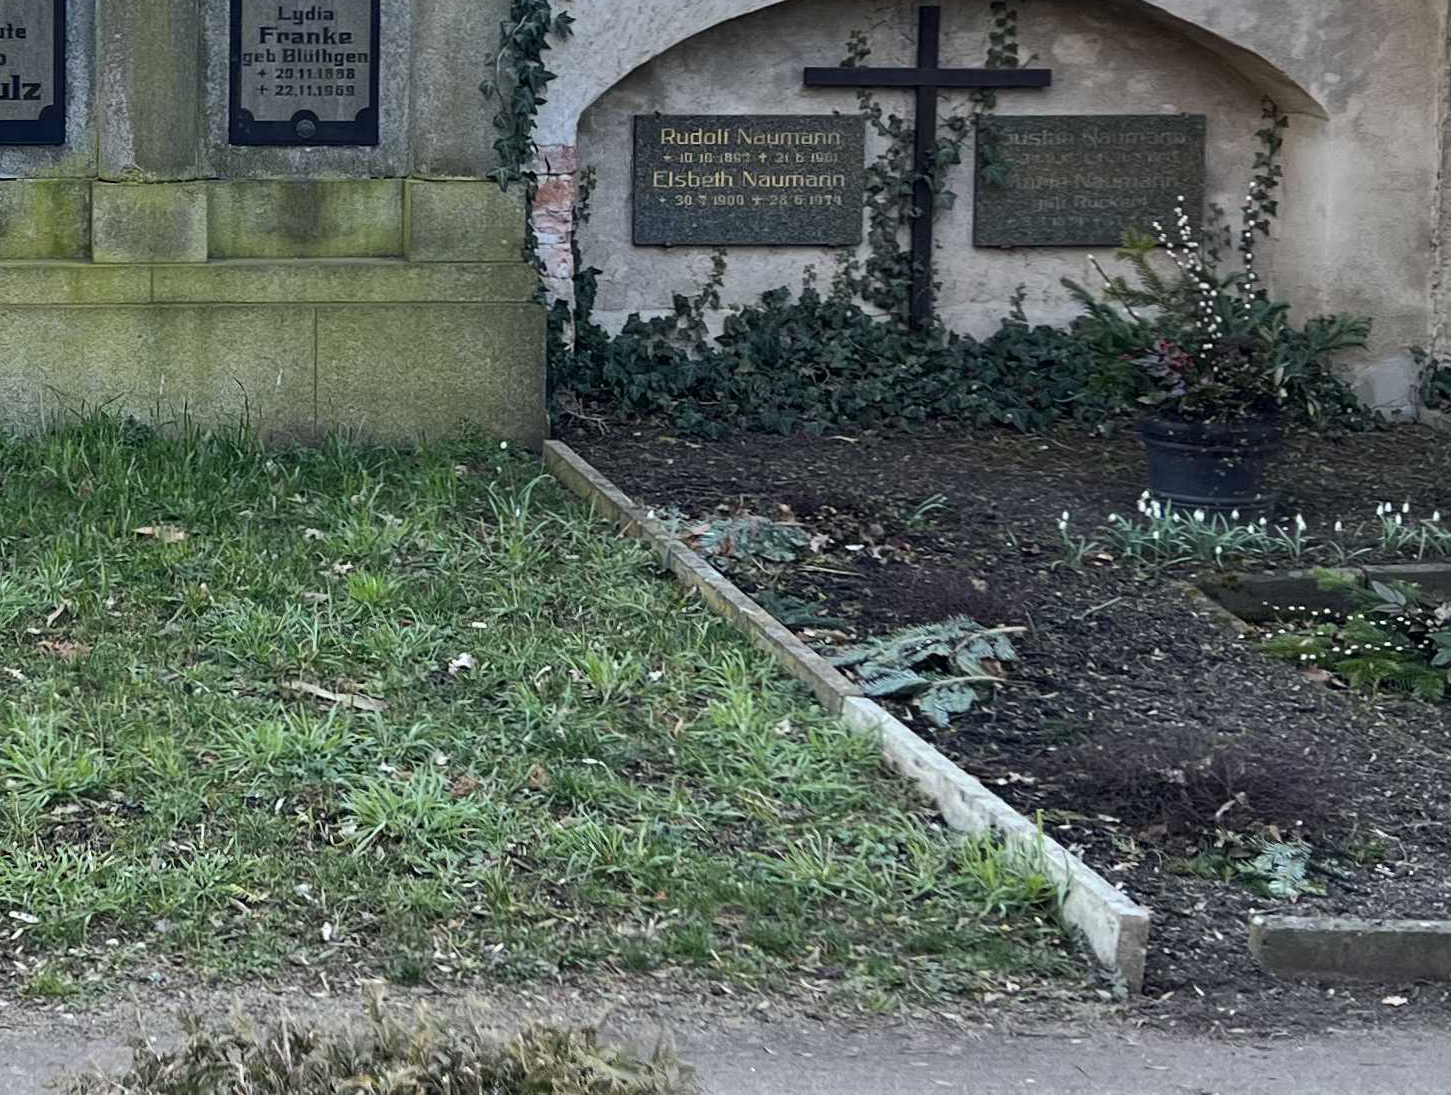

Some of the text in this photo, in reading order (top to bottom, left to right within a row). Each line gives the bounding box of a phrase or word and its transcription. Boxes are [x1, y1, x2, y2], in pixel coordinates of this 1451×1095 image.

[277, 5, 334, 25] Lydia
[259, 26, 354, 45] Franke
[282, 48, 368, 66] Blüthgen
[660, 127, 841, 145] Rudolf Naumann
[652, 169, 846, 189] Elsbeth Naumann
